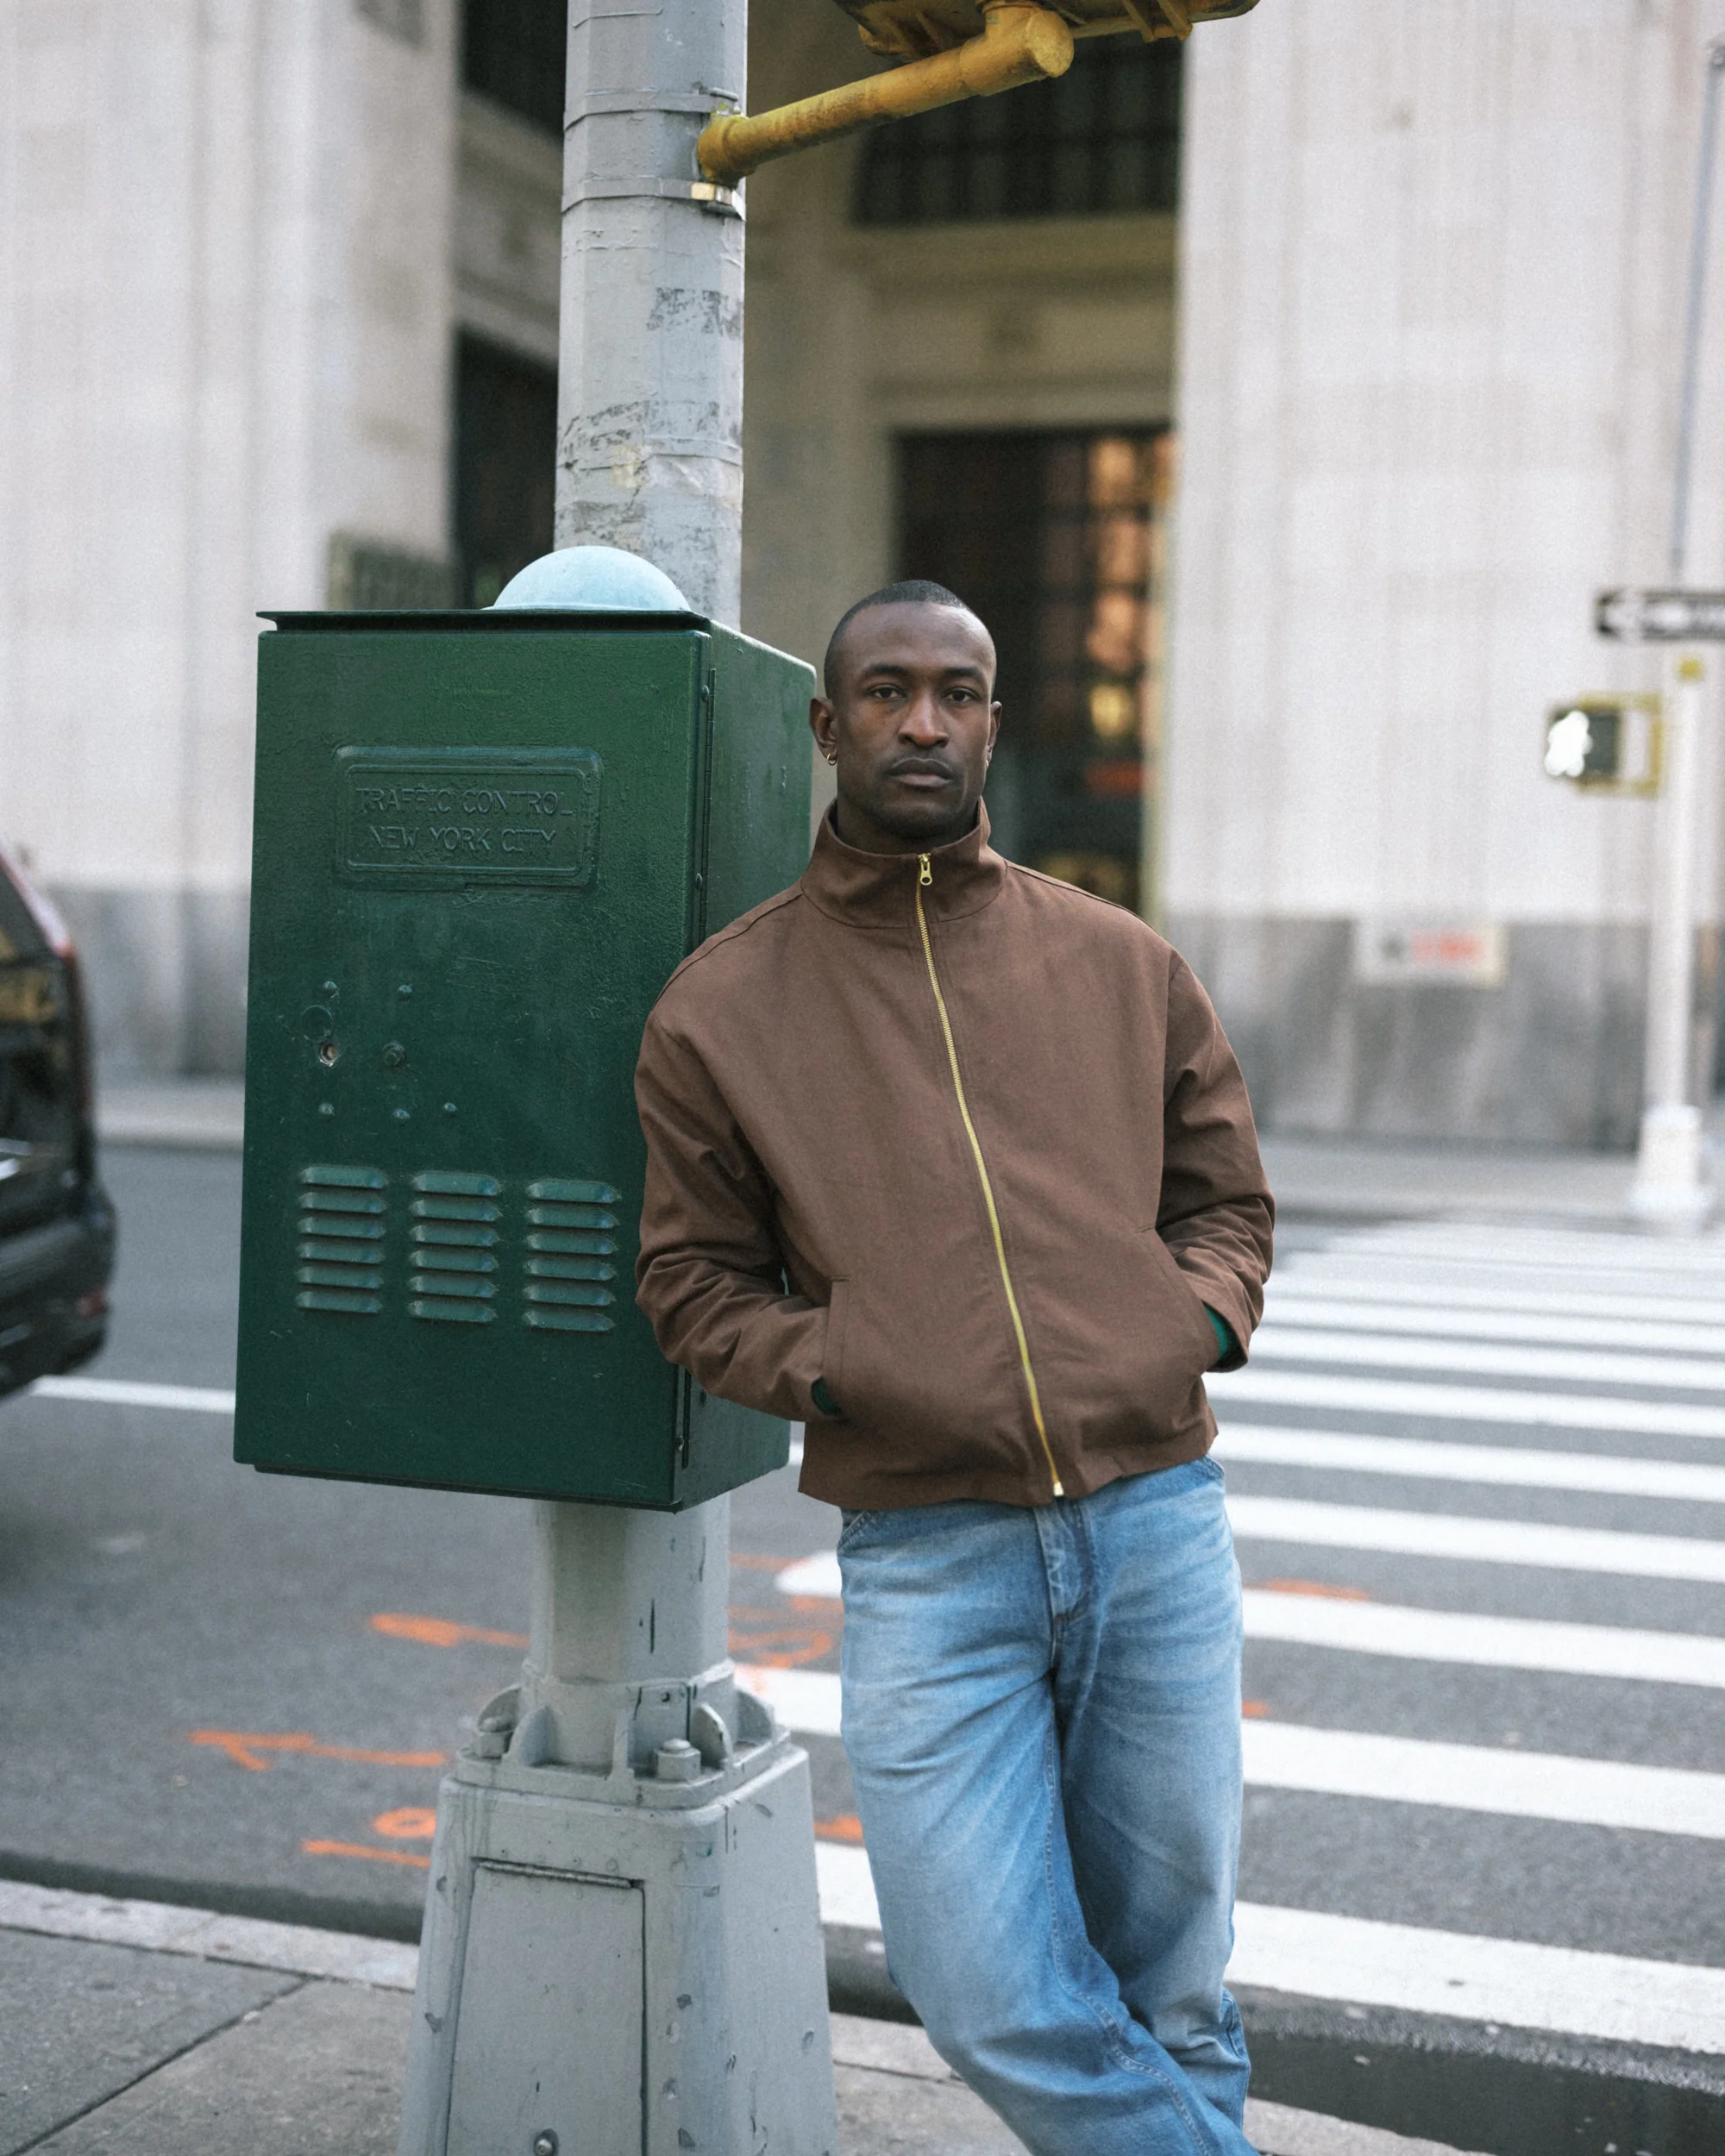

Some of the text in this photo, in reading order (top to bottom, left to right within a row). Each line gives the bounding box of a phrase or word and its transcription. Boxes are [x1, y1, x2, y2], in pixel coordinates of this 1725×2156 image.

[354, 787, 574, 816] TRAFFIC CONTROL
[369, 825, 556, 853] NEW YORK CITY
